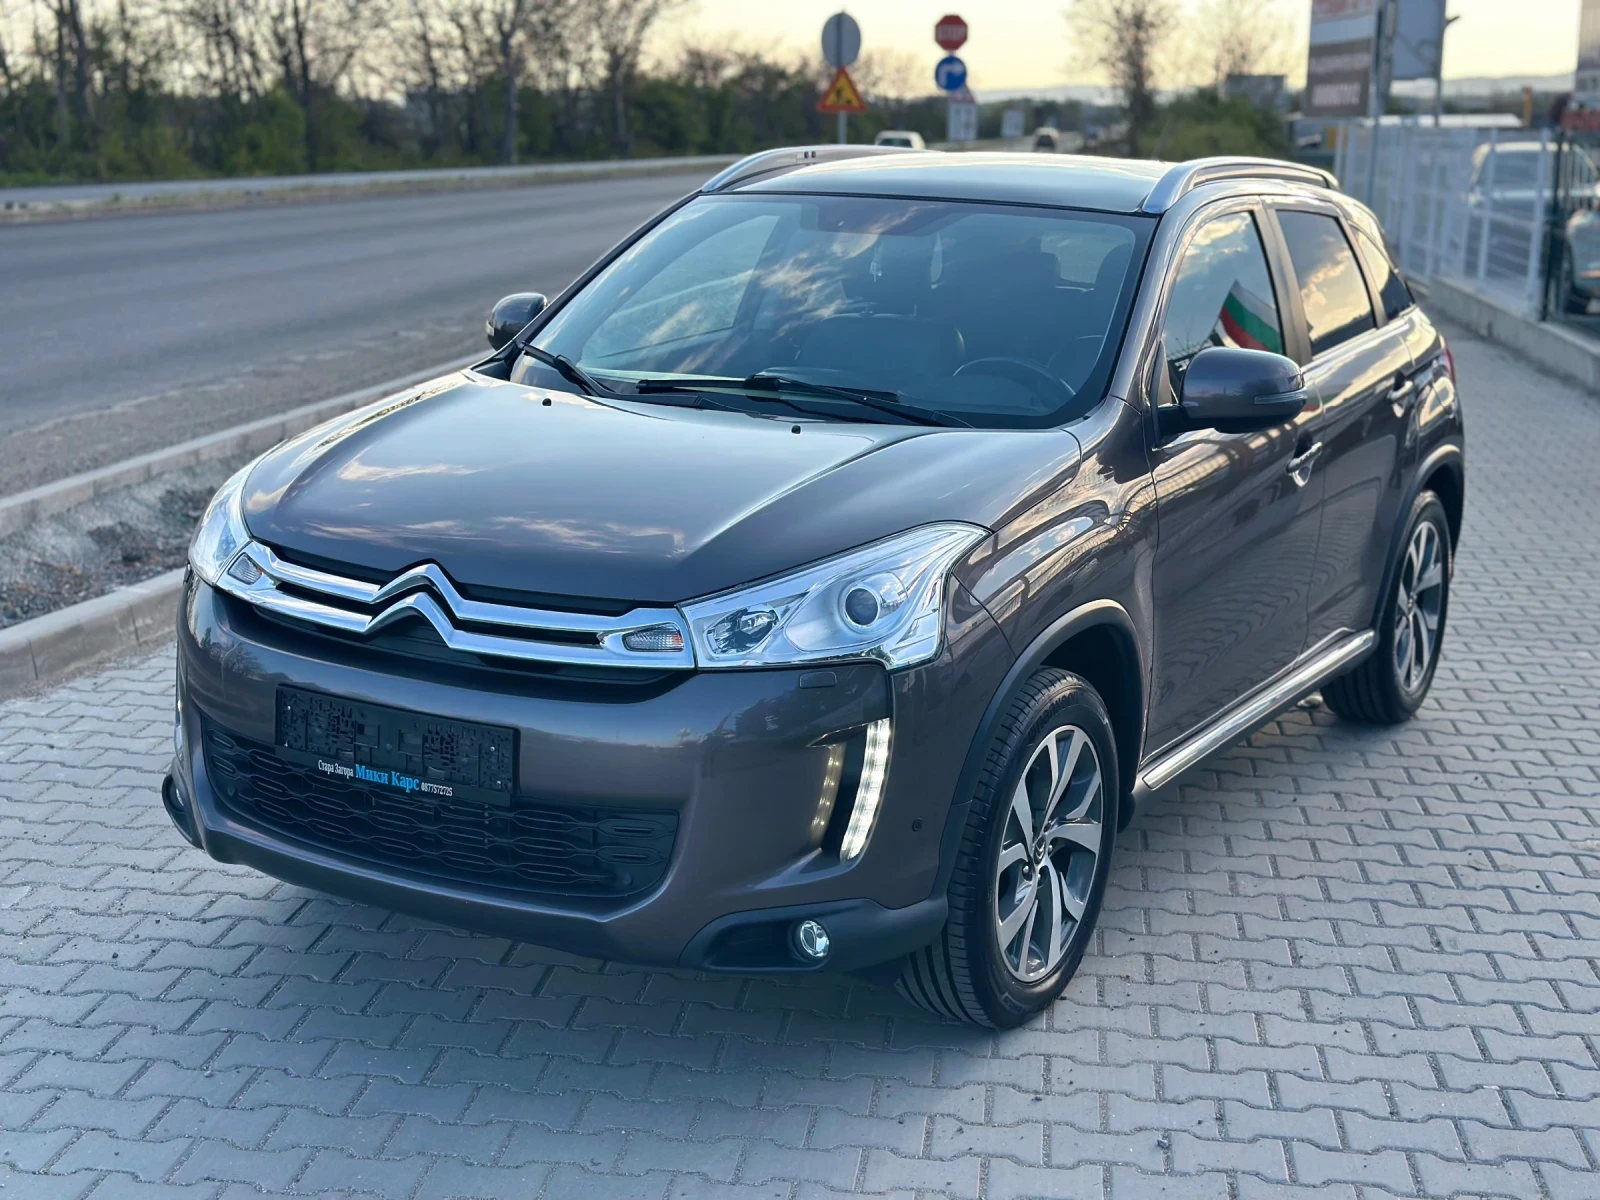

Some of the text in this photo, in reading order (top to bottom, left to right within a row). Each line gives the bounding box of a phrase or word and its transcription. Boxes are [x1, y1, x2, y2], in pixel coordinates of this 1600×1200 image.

[318, 759, 335, 774] Стара
[335, 762, 354, 779] Загора
[355, 764, 388, 784] Мики
[391, 771, 420, 793] Карс
